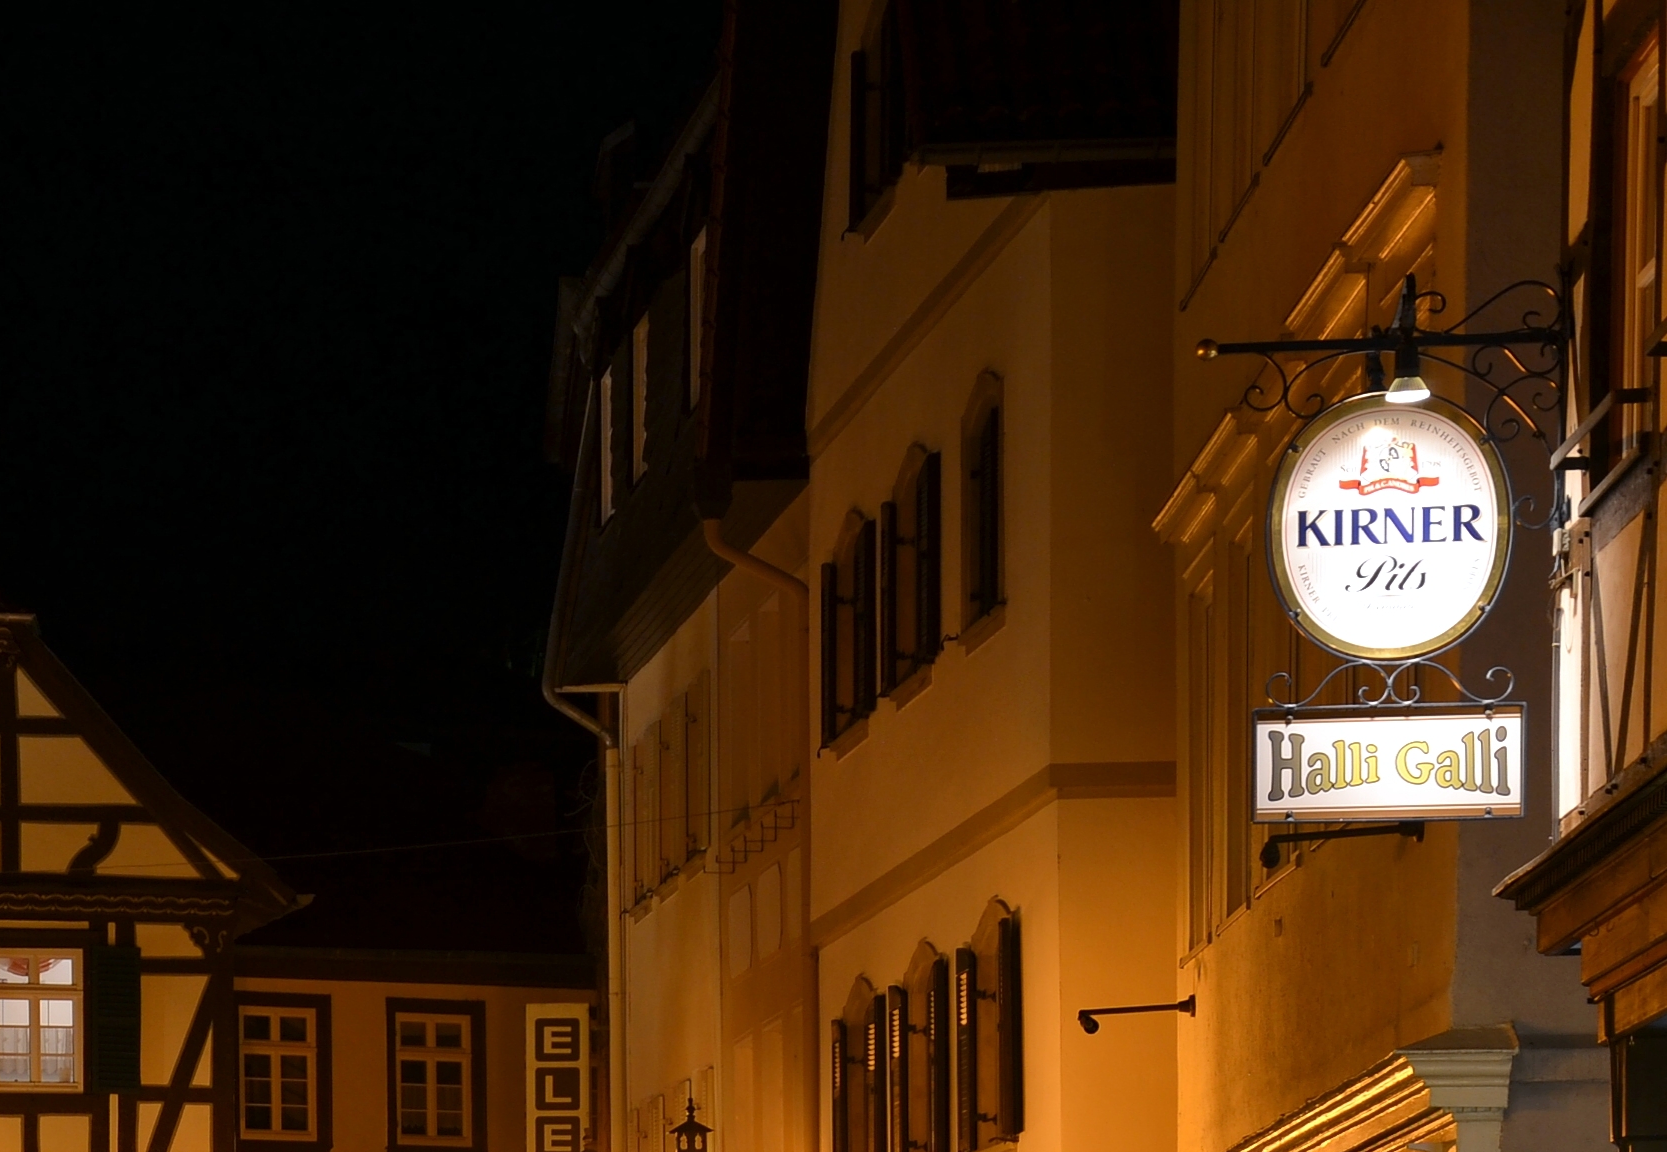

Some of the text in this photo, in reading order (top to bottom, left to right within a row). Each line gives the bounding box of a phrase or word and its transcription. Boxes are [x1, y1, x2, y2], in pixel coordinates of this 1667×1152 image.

[1298, 417, 1483, 499] GEBRAUT NACH DEM REINHEITSGEBOT
[1296, 504, 1488, 549] KIRNER
[1344, 555, 1427, 593] Pils
[1267, 725, 1511, 802] Halli Galli
